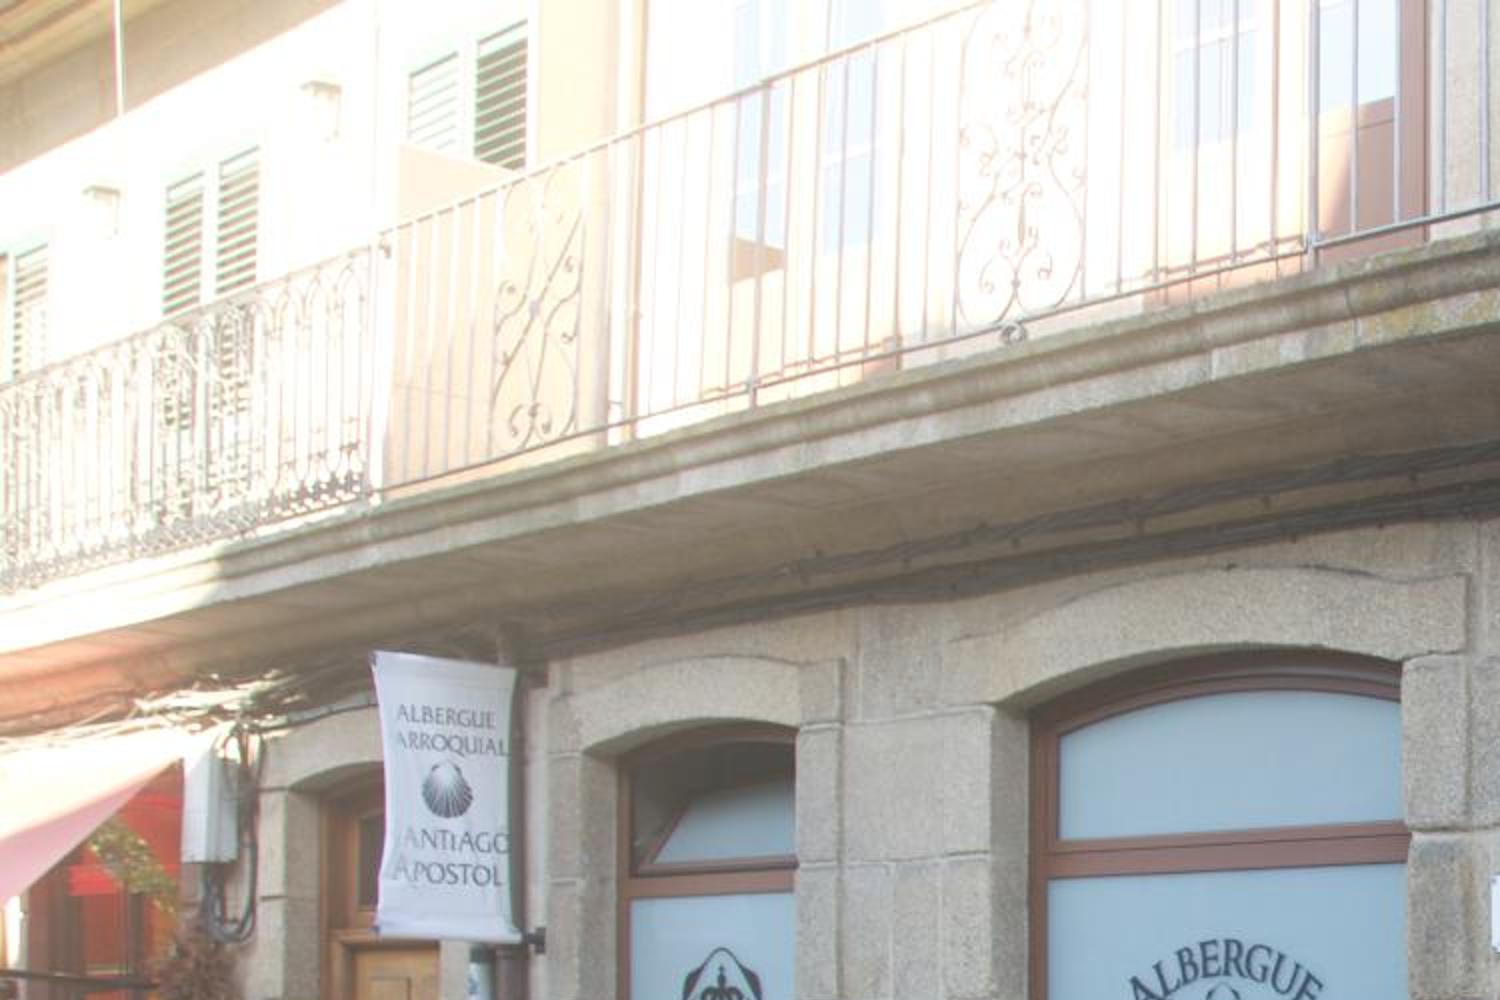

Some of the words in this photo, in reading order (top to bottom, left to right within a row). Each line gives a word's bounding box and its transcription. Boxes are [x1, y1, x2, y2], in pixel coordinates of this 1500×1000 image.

[396, 703, 496, 730] ALBERGUE
[395, 730, 509, 758] ARROQUIAL
[402, 826, 509, 854] ANTIAGO
[391, 853, 503, 888] APOSTOL
